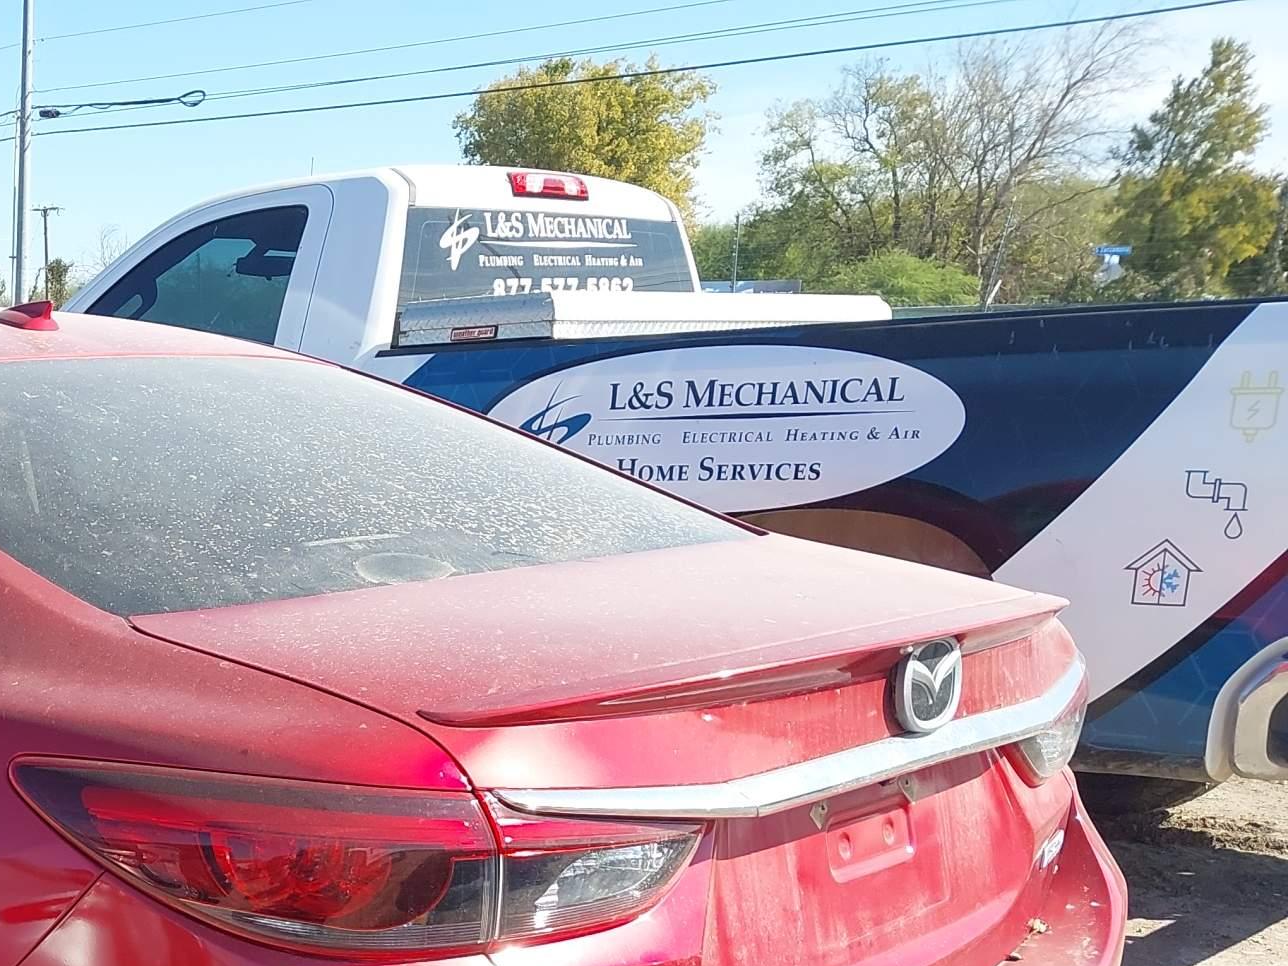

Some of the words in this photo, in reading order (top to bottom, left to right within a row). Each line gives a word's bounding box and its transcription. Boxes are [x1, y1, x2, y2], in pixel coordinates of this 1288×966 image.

[483, 211, 524, 237] L&S
[527, 212, 632, 240] MECHANICAL
[478, 254, 524, 267] PLUMBING
[533, 253, 581, 267] ELECTRICAL
[620, 254, 628, 267] &
[629, 255, 643, 267] AIR
[609, 380, 673, 411] L&S
[683, 376, 905, 409] MECHANICAL
[588, 433, 662, 447] PLUMBING
[682, 431, 773, 445] ELECTRICAL
[785, 428, 859, 442] HEATING
[867, 427, 881, 441] &
[888, 427, 921, 441] AIR
[616, 458, 690, 482] HOME
[698, 456, 822, 482] SERVICES
